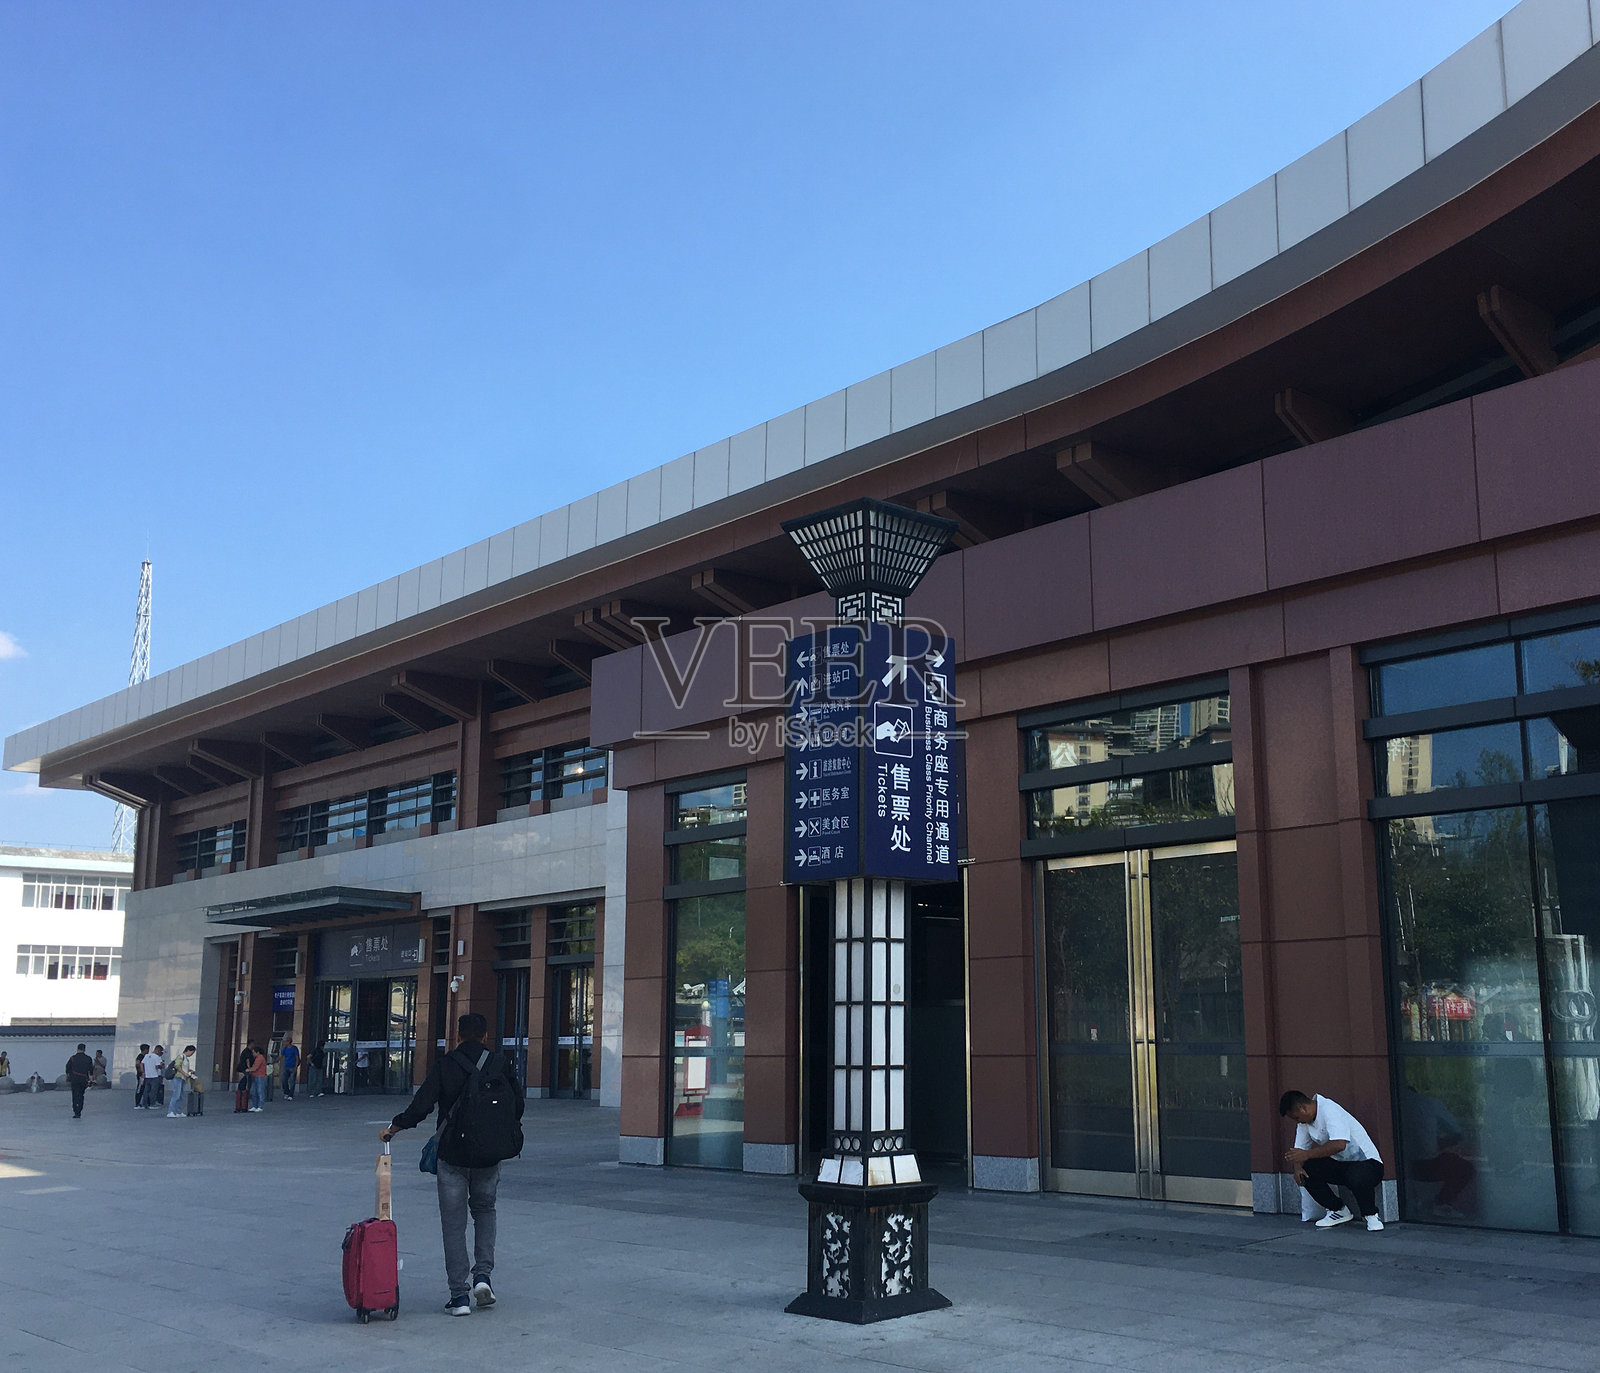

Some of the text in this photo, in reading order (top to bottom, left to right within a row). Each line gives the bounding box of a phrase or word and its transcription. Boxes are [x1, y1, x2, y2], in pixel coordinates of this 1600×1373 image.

[823, 641, 850, 659] 售票处
[823, 669, 850, 686] 进站口
[822, 786, 850, 801] 医务室
[878, 763, 888, 817] Tickets
[925, 706, 934, 864] Business Class Priority Channel
[933, 708, 950, 864] 商务座专用通道
[890, 762, 911, 852] 售票处
[822, 816, 850, 830] 美食区
[821, 845, 844, 859] 酒店
[365, 936, 389, 952] 售票处
